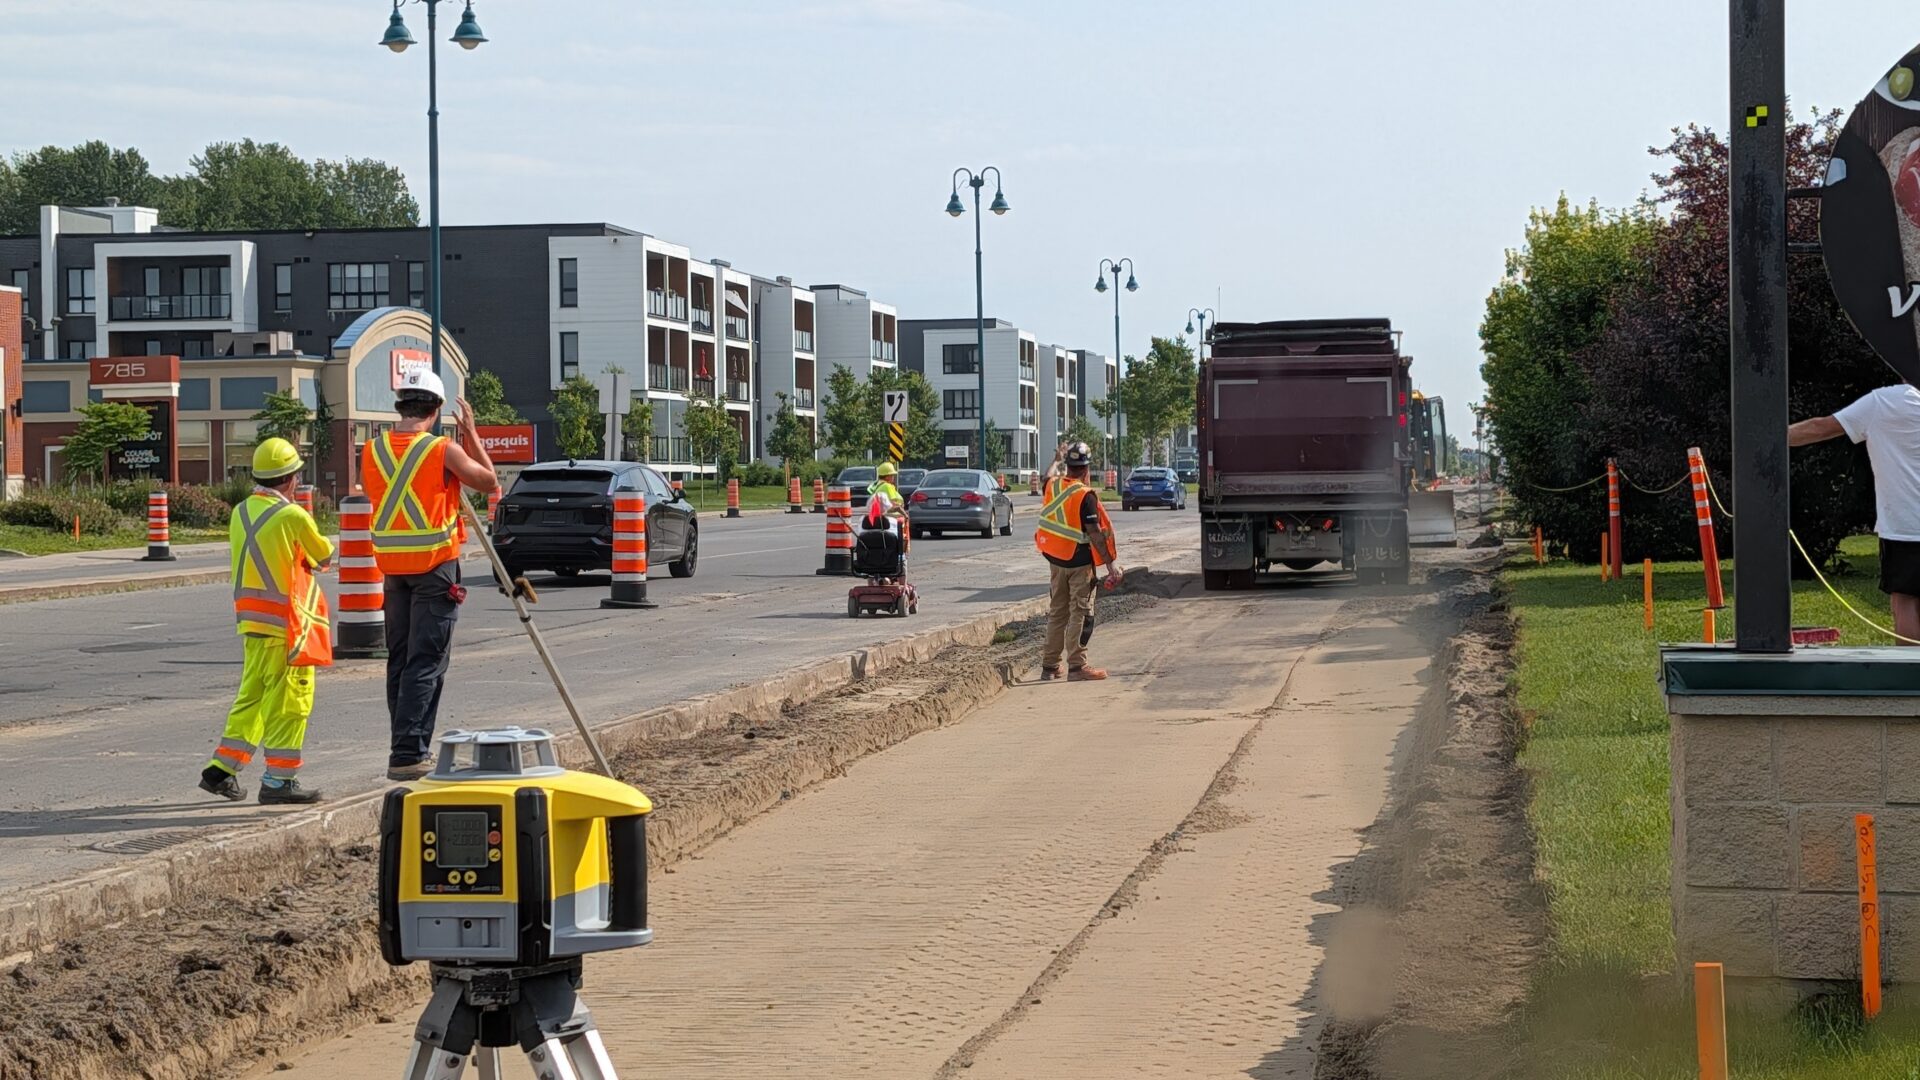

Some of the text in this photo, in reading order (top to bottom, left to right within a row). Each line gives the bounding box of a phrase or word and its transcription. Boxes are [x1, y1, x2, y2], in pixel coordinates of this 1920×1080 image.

[100, 363, 145, 377] 785
[479, 434, 529, 449] ggsquis
[119, 456, 160, 464] PLANCHERS
